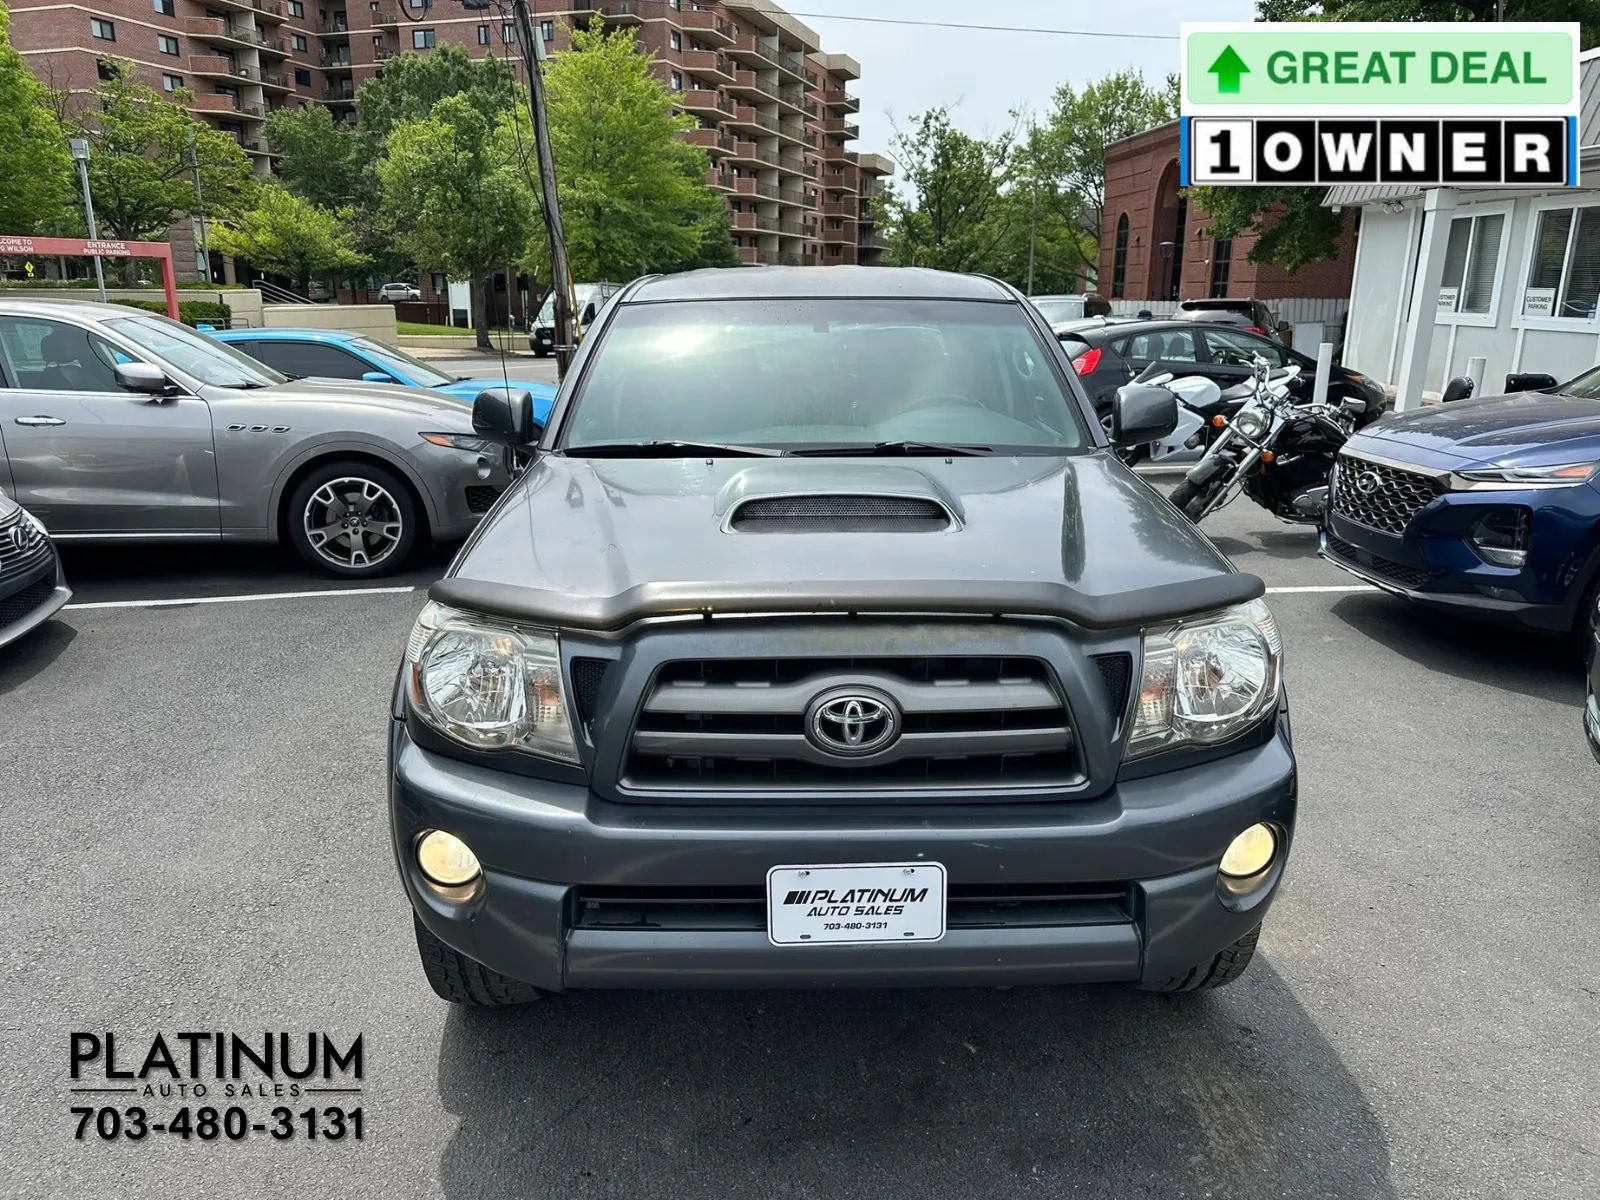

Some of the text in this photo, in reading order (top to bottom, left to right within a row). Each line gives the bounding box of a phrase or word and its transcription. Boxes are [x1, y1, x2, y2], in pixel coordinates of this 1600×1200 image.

[6, 245, 34, 253] WILSON
[87, 241, 126, 249] ENTRANCE
[1526, 295, 1552, 303] CUSTOMER
[810, 888, 929, 904] PLATINUM
[806, 905, 904, 917] AUTO SALES
[823, 922, 888, 930] 703-480-3131
